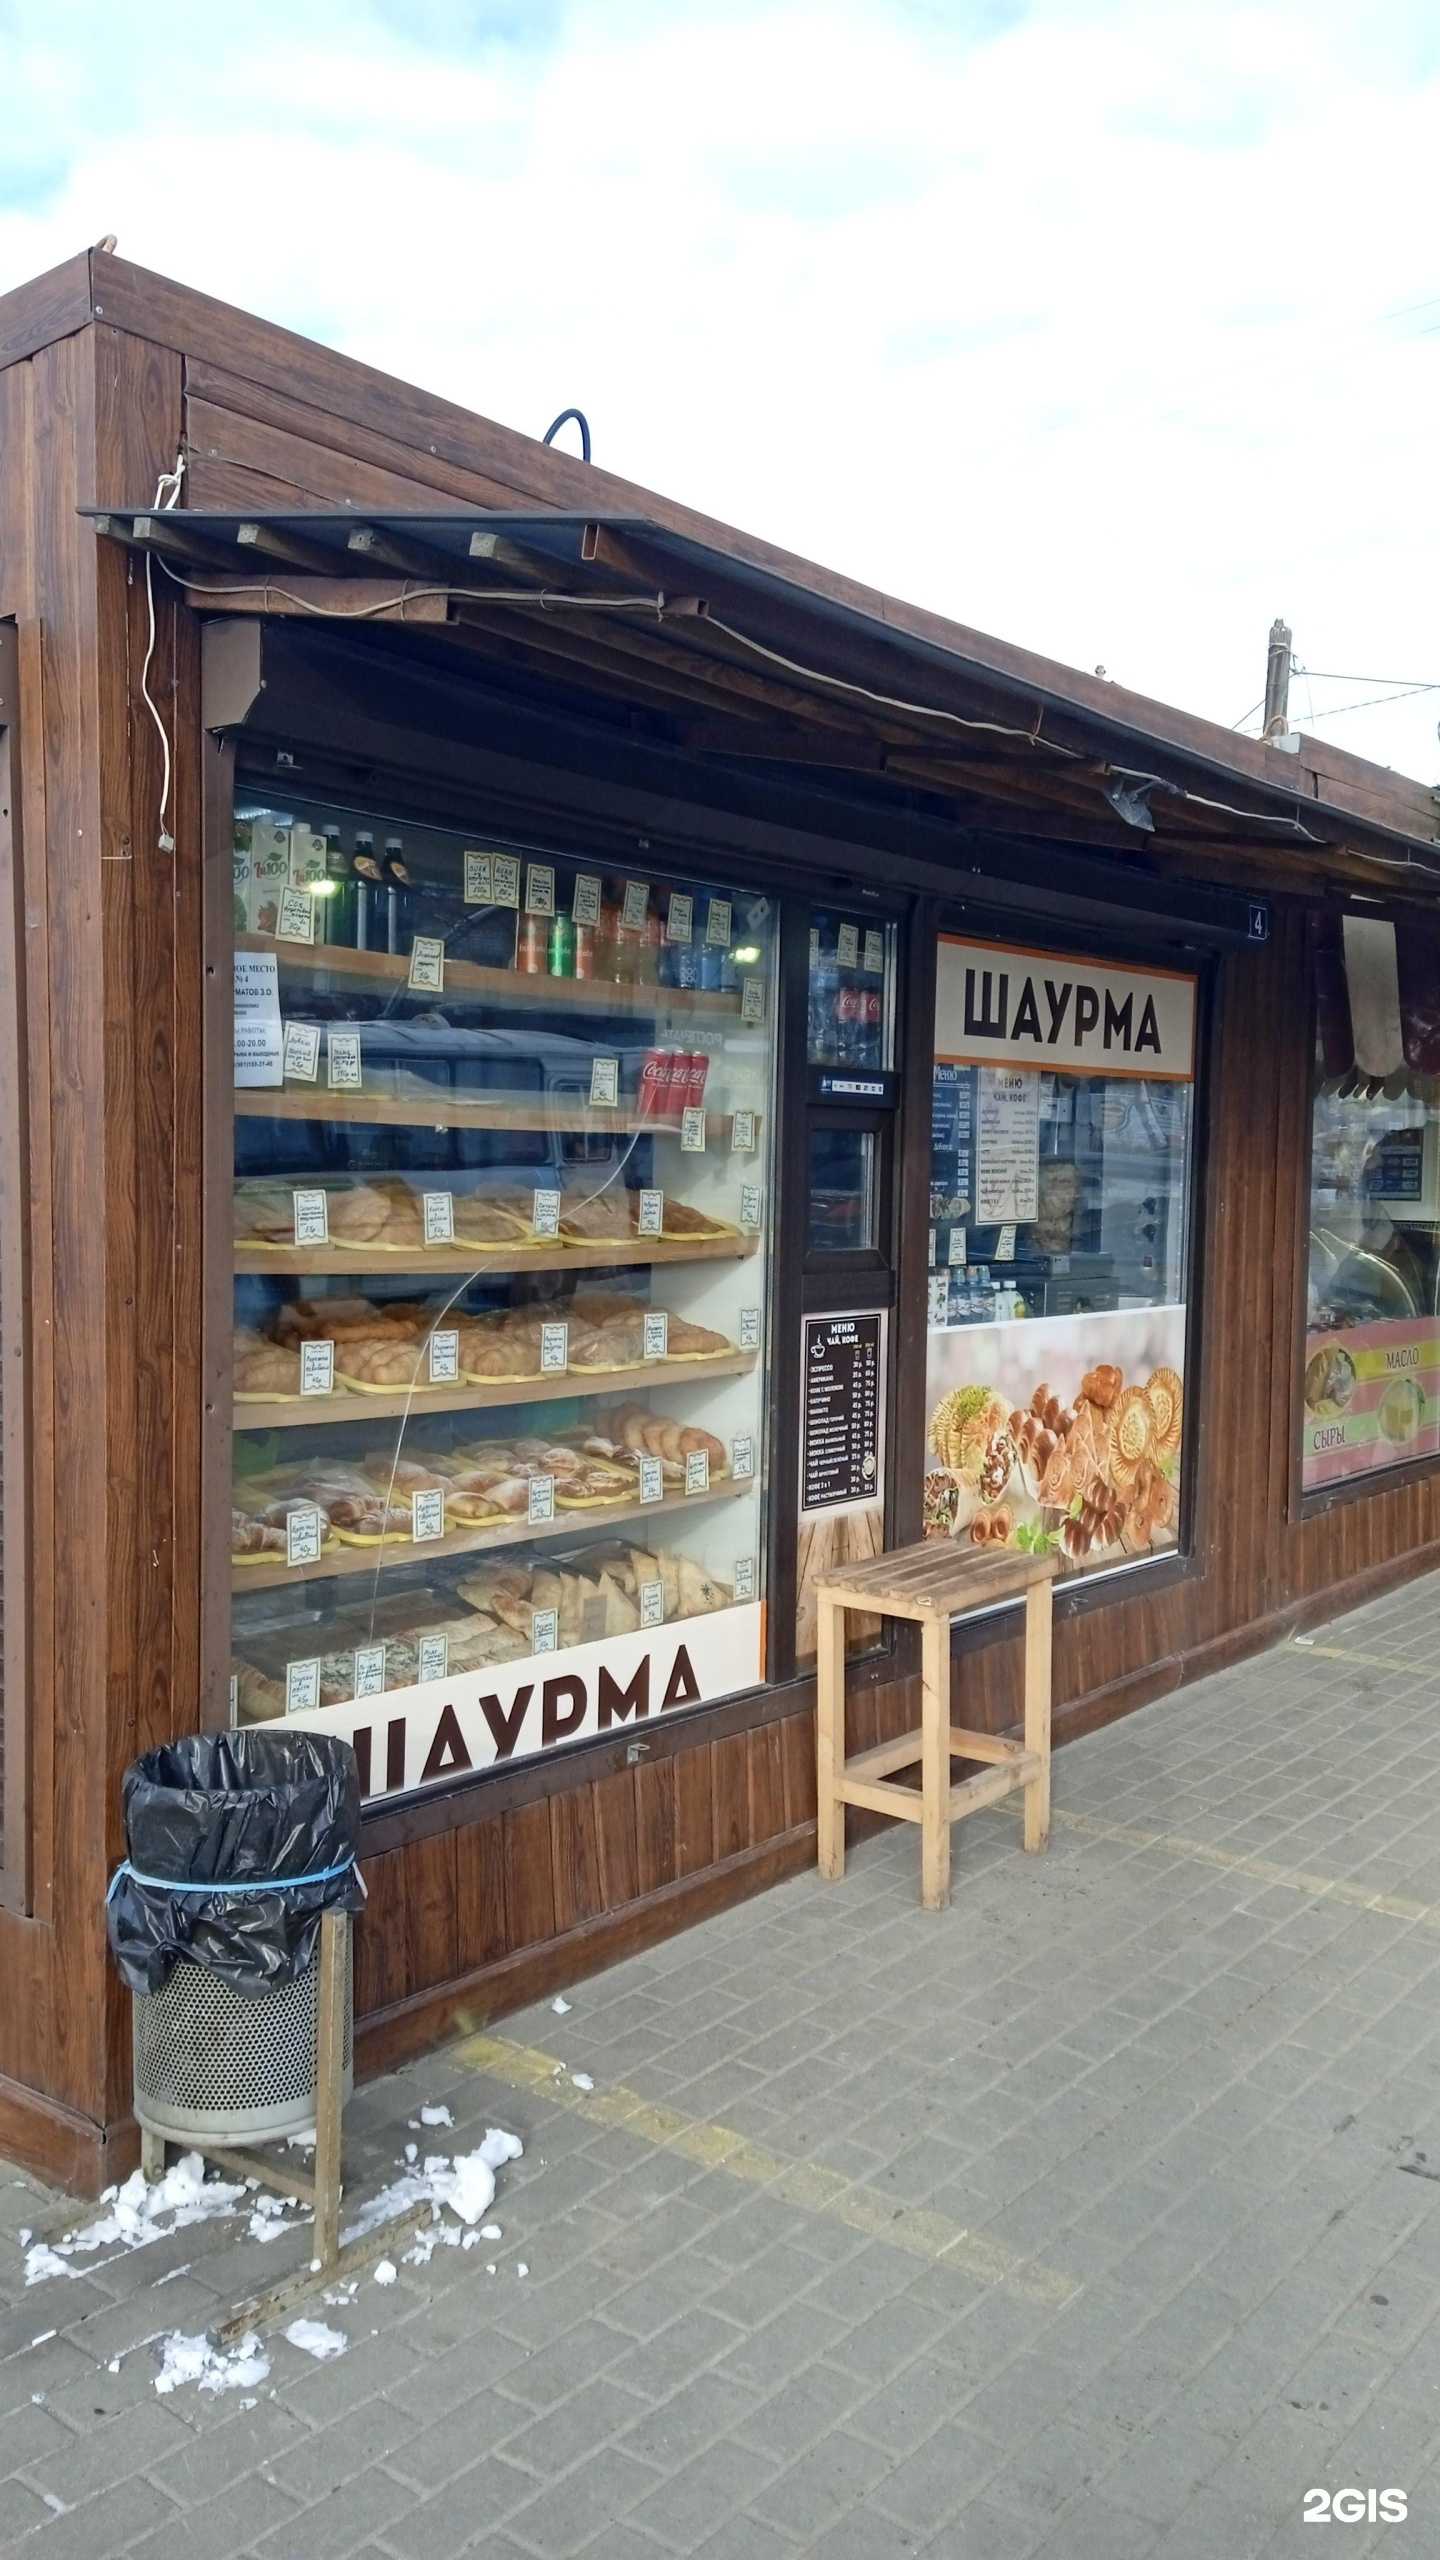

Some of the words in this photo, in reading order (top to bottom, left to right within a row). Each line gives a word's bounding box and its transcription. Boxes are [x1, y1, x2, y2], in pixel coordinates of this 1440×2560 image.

[1254, 911, 1263, 935] 4
[964, 968, 1162, 1054] ШАУРМА
[831, 1323, 855, 1334] МЕНЮ
[1386, 1347, 1419, 1368] МАСЛО
[1313, 1426, 1345, 1450] СЫРЫ
